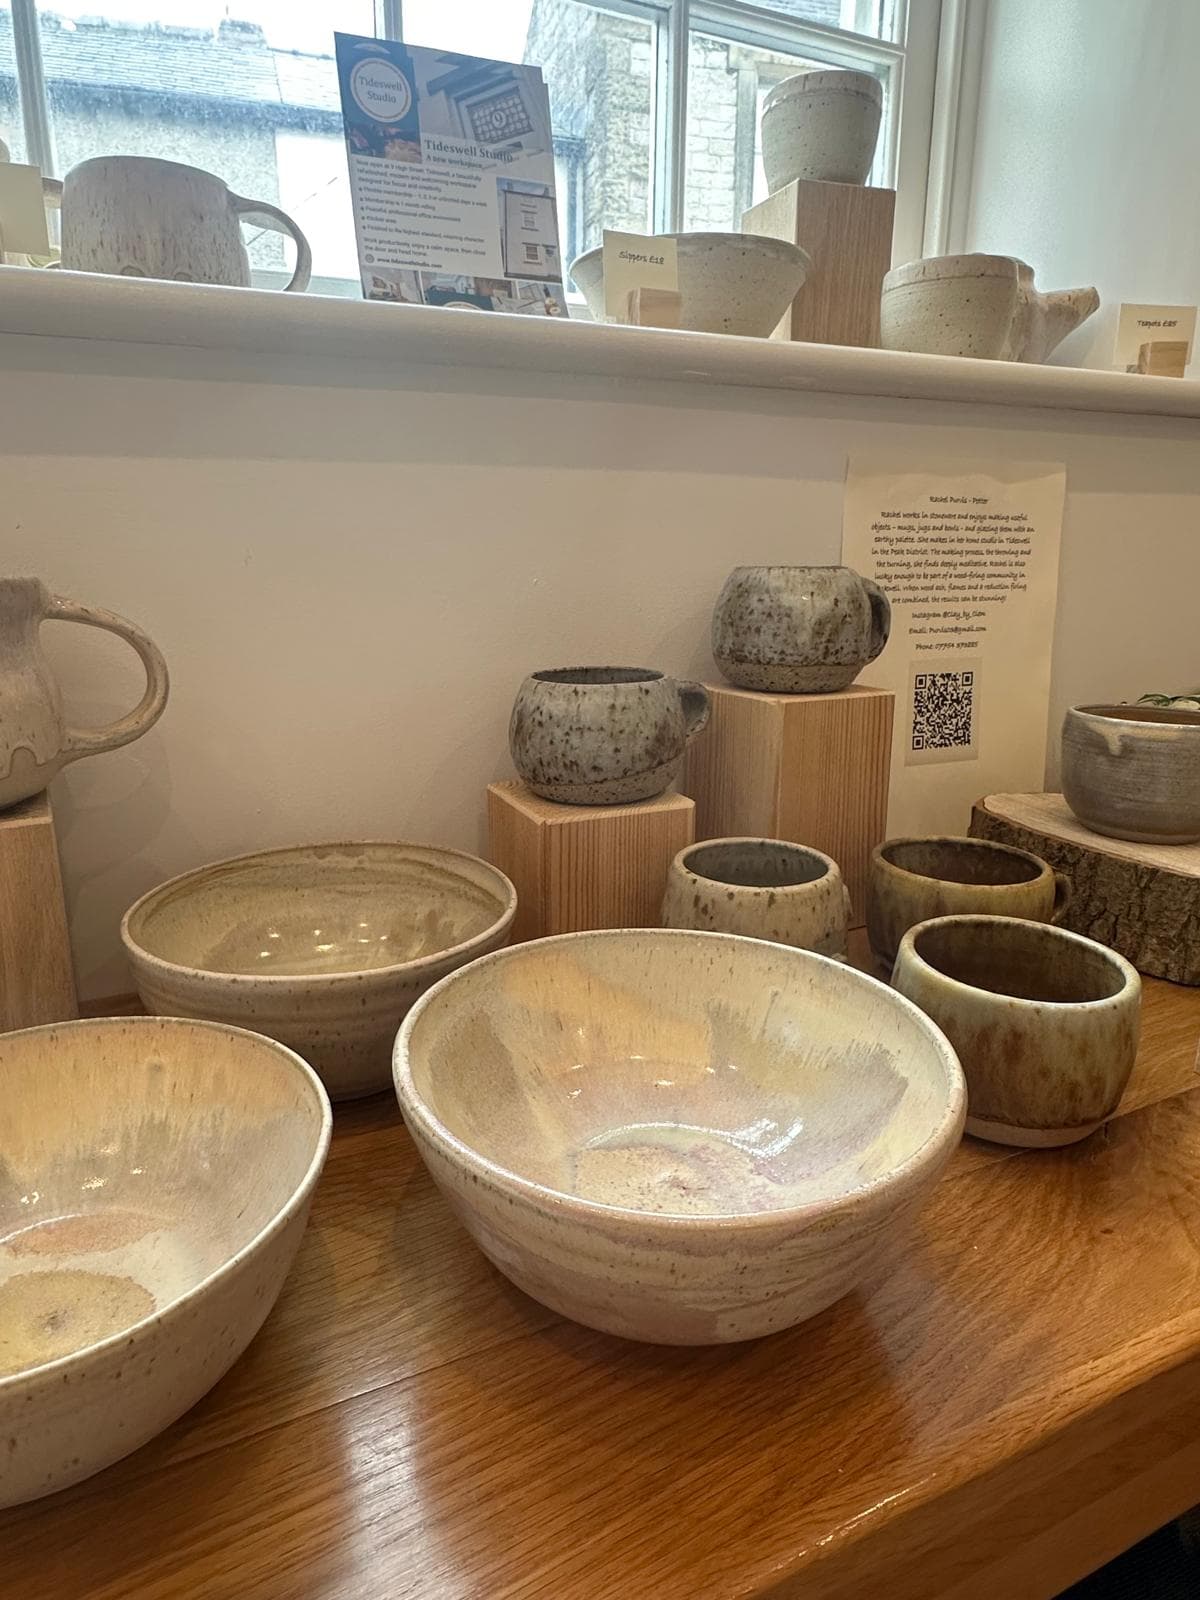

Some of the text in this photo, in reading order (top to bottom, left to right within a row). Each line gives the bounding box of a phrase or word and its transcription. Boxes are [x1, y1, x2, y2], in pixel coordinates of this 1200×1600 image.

[359, 76, 402, 92] Tideswell
[367, 91, 397, 104] Studio
[424, 139, 513, 163] Tideswell Studio
[433, 155, 446, 163] new
[988, 513, 1009, 523] making
[871, 521, 891, 533] objects
[941, 549, 964, 557] making
[924, 559, 940, 569] finds
[894, 573, 915, 582] enough
[929, 572, 942, 580] part
[912, 612, 941, 620] Instagram
